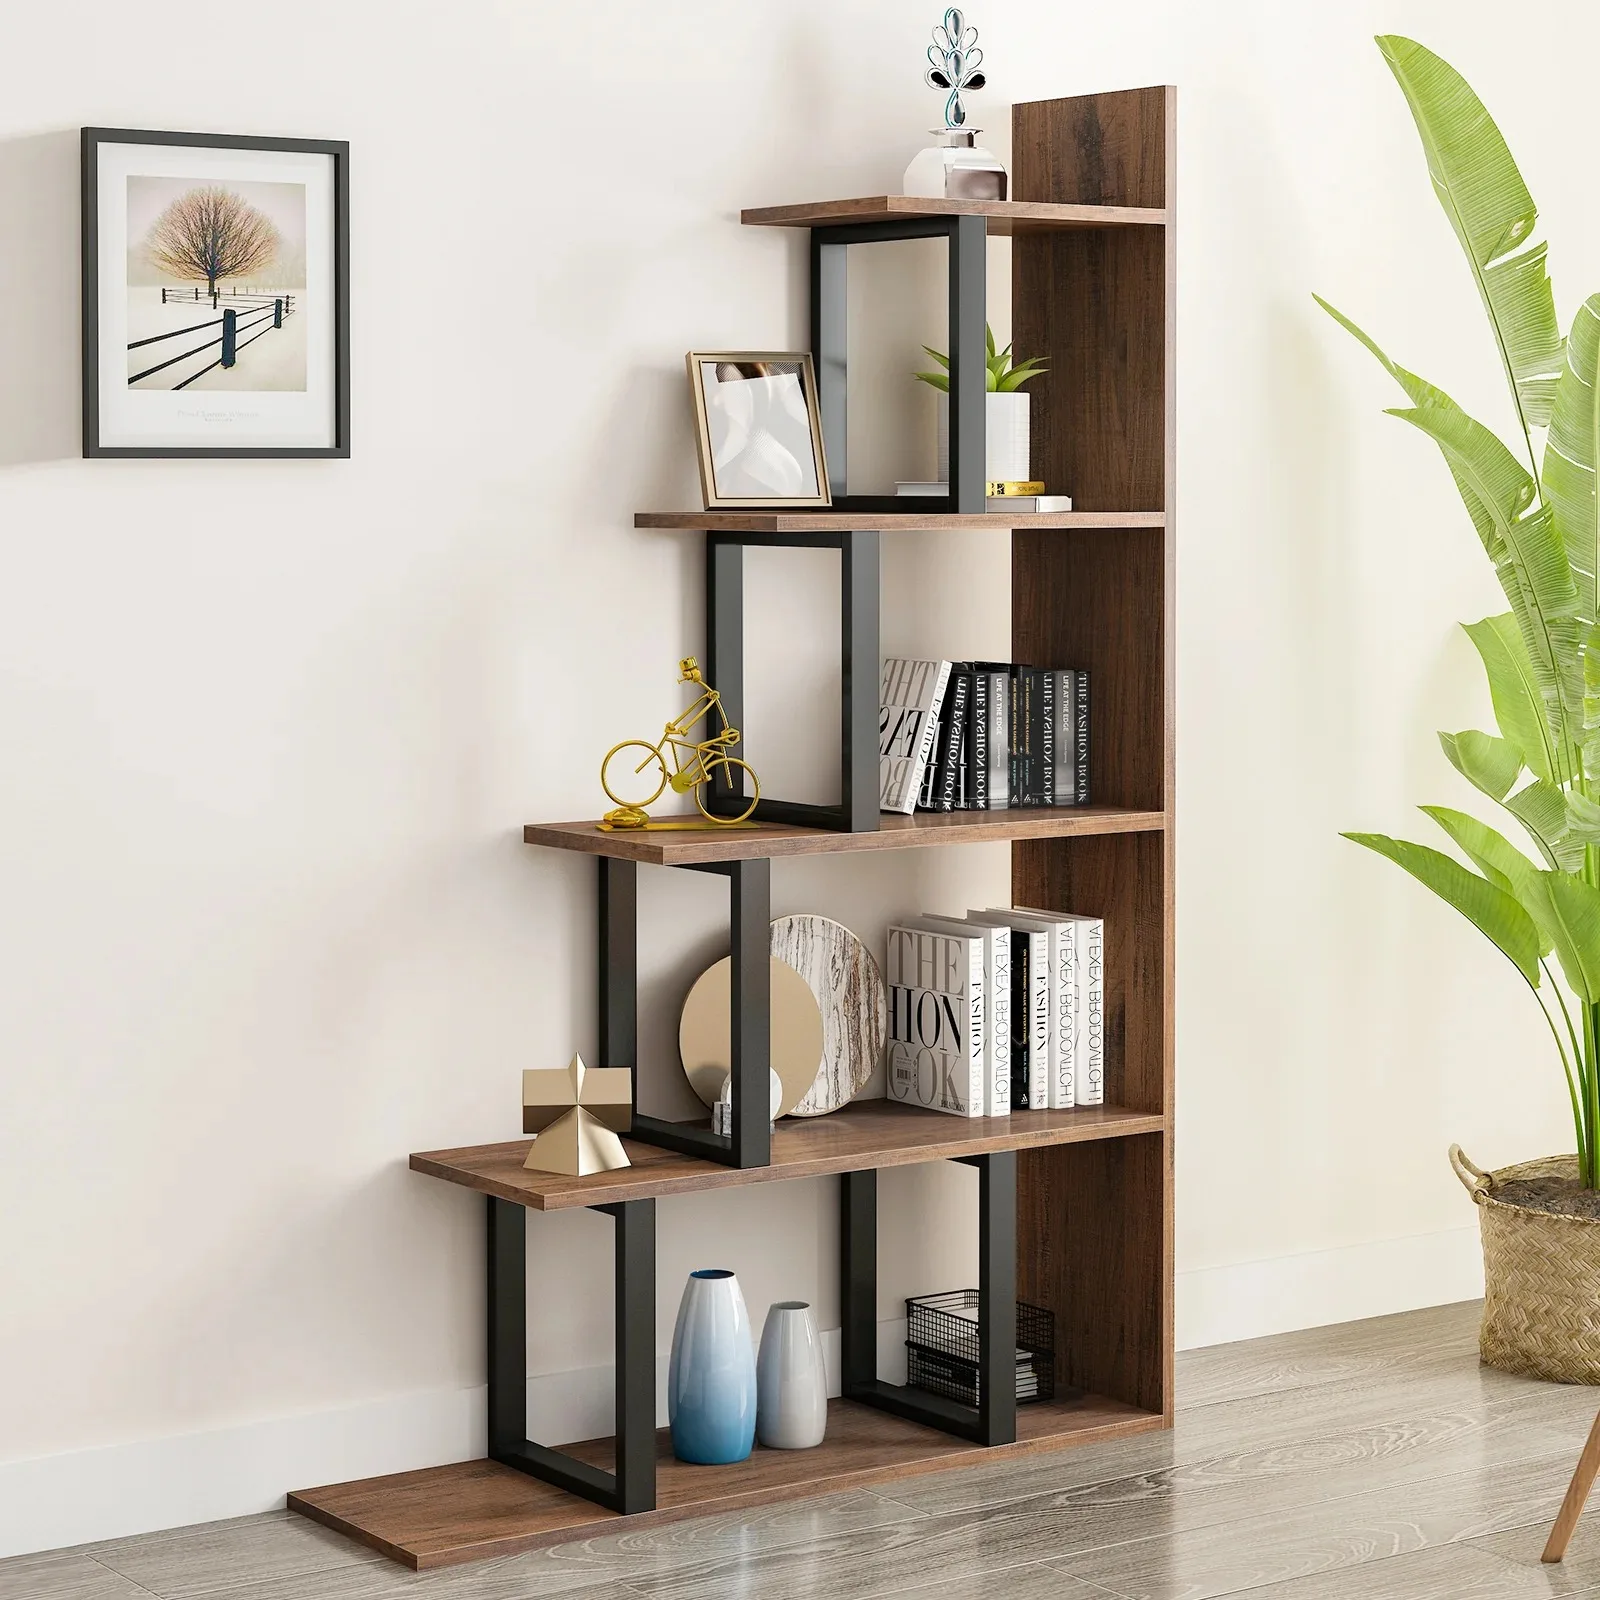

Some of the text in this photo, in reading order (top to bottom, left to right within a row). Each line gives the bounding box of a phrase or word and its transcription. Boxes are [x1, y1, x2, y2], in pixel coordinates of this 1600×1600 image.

[1078, 673, 1087, 802] THE FASHION BOOK
[889, 929, 964, 996] THE
[1036, 935, 1046, 971] THE
[971, 982, 981, 1058] FASHION
[1036, 976, 1046, 1051] FASHION
